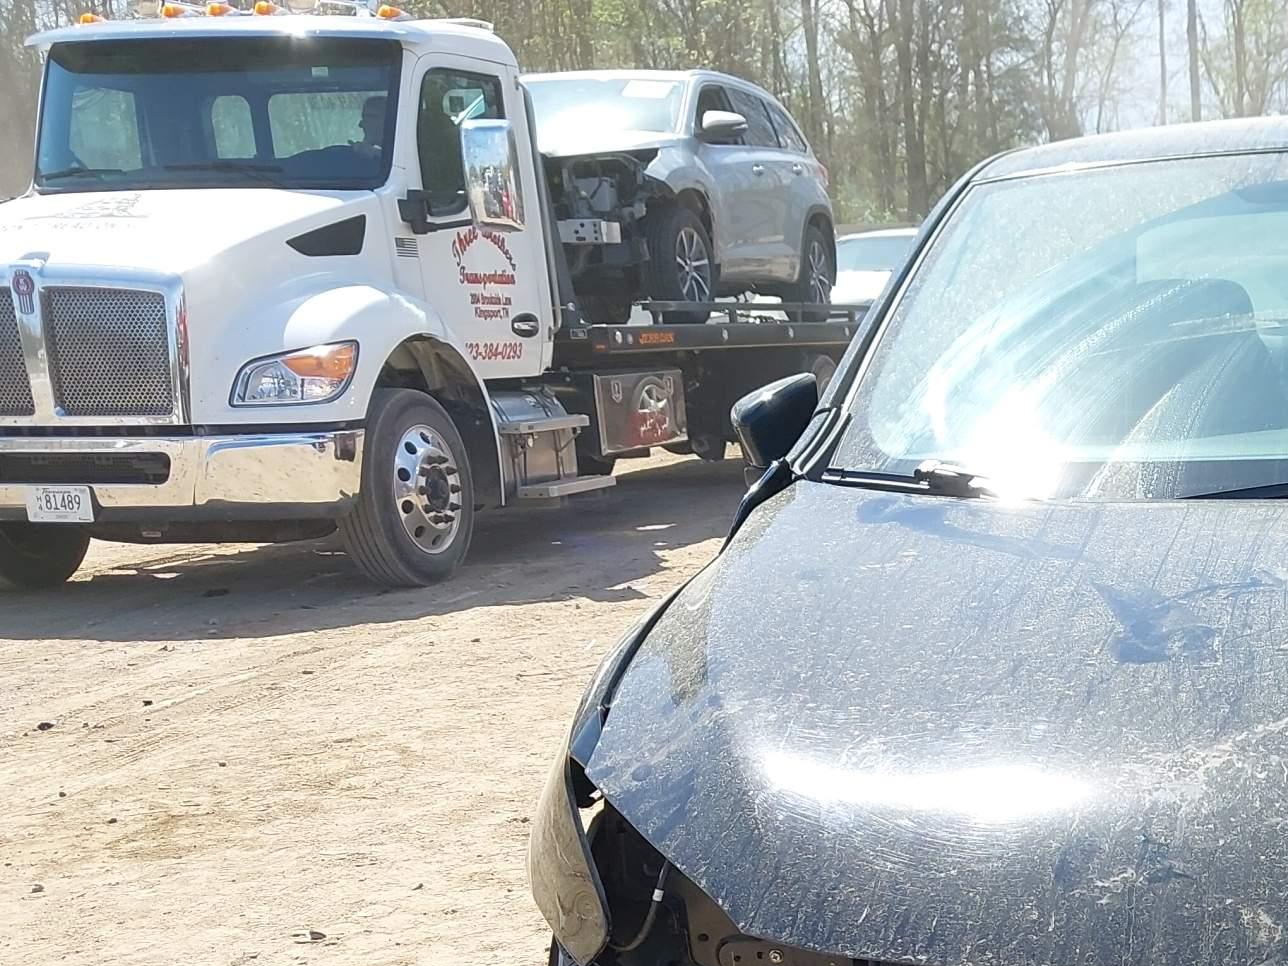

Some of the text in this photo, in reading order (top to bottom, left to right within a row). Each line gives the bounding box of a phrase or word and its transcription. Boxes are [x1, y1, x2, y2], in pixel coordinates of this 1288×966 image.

[451, 226, 478, 267] Three
[459, 266, 515, 290] Transportation
[465, 342, 522, 360] 23-384-0293
[44, 494, 81, 511] 81489
